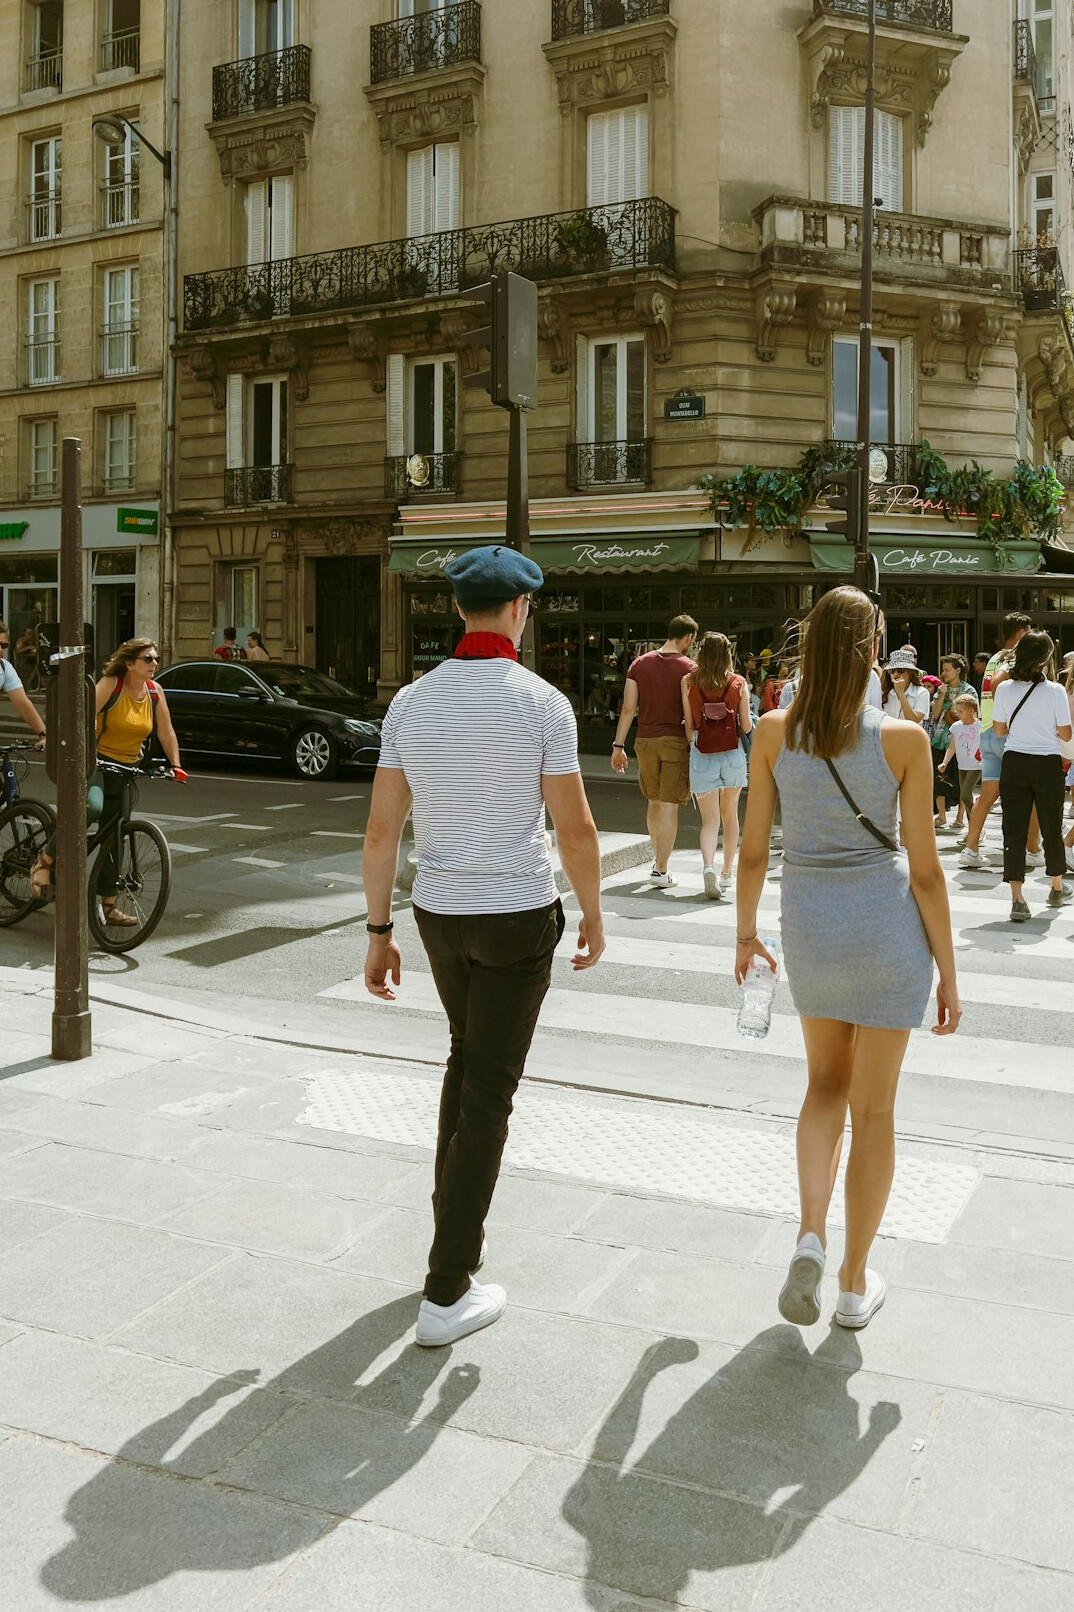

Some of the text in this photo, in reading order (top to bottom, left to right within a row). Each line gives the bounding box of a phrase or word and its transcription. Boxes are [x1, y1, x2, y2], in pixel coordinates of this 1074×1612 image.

[123, 516, 156, 526] SUBWAY
[416, 542, 670, 568] Café Restaurant
[882, 549, 980, 569] Café Paris
